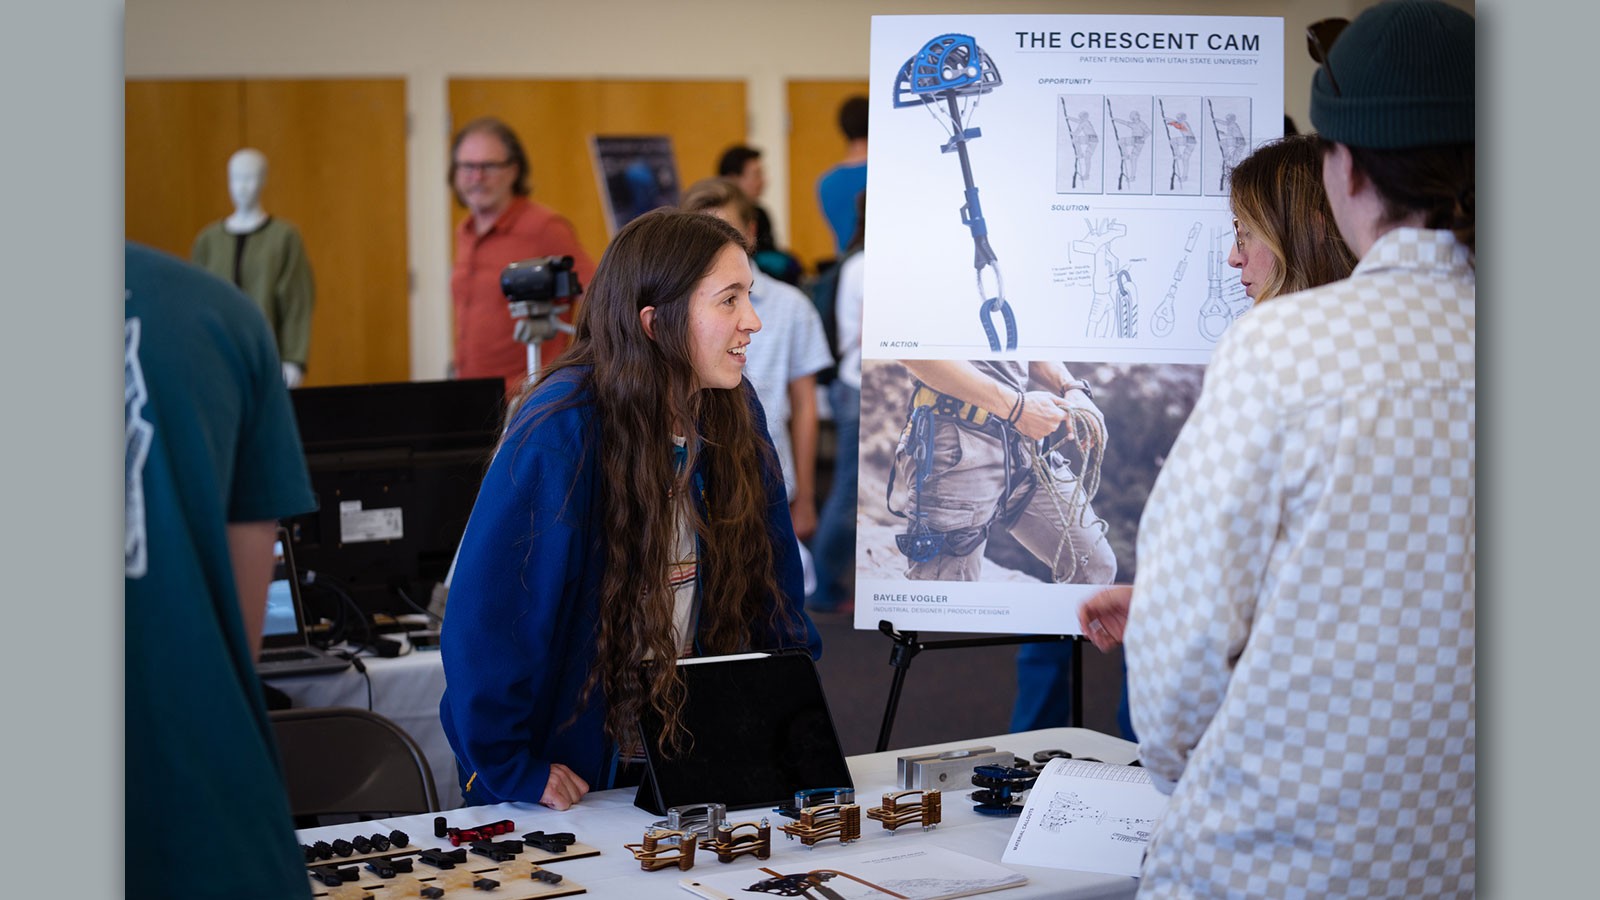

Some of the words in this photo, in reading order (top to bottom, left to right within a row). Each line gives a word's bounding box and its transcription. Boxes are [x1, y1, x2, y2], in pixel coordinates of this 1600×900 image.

[1015, 32, 1061, 48] THE
[1070, 32, 1199, 50] CRESCENT
[1208, 34, 1260, 51] CAM
[873, 594, 907, 602] BAYLEE
[910, 594, 948, 603] VOGLER
[1013, 830, 1025, 850] MATERIAL
[1022, 808, 1034, 830] CALLOUTS
